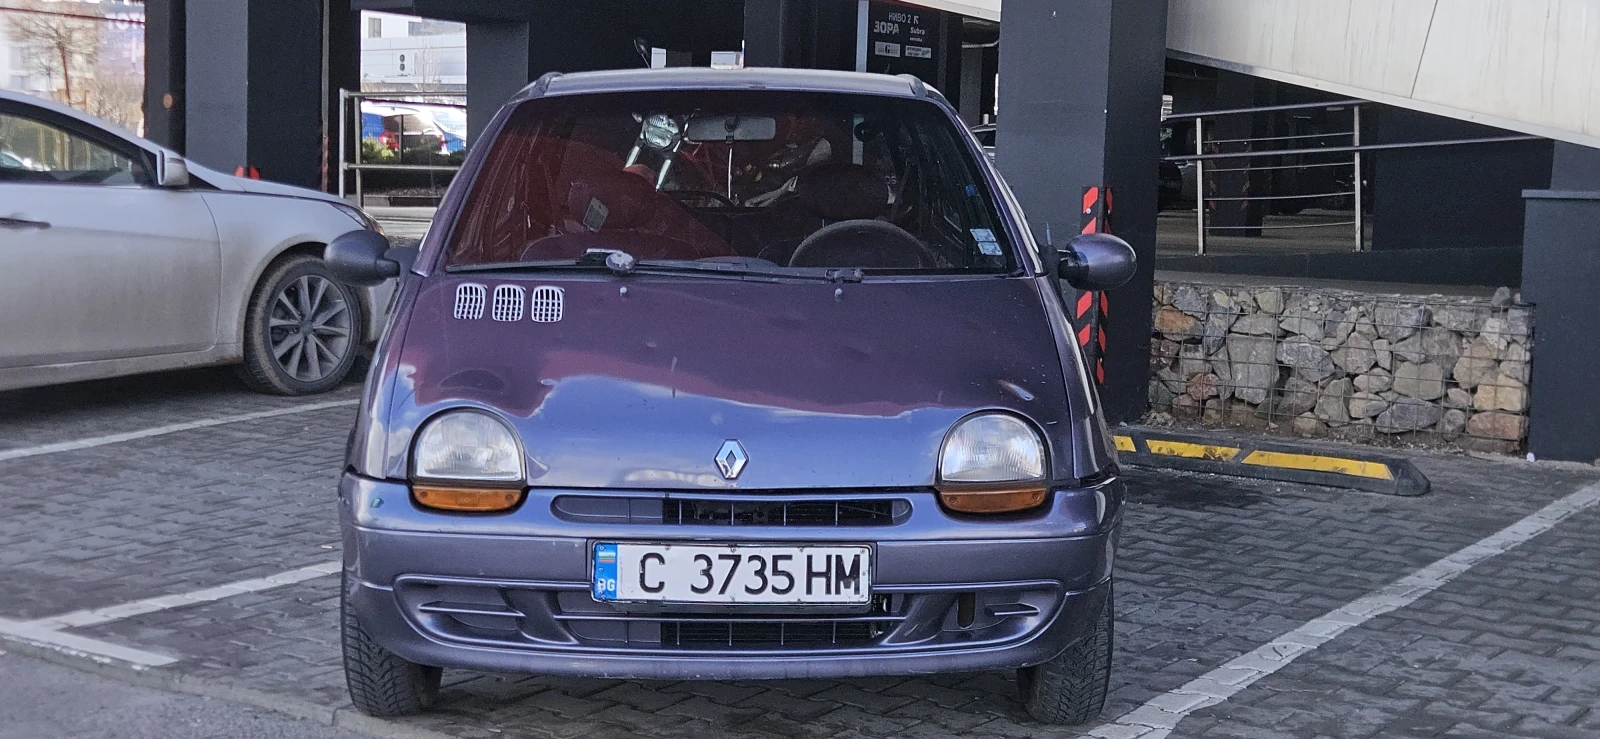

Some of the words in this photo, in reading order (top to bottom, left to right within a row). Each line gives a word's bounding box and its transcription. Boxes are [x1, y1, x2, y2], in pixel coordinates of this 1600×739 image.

[907, 15, 911, 23] 2
[873, 20, 900, 34] ЗОРА
[639, 552, 666, 594] C
[690, 554, 795, 595] 3735
[805, 554, 861, 596] HM
[597, 578, 616, 592] BG
